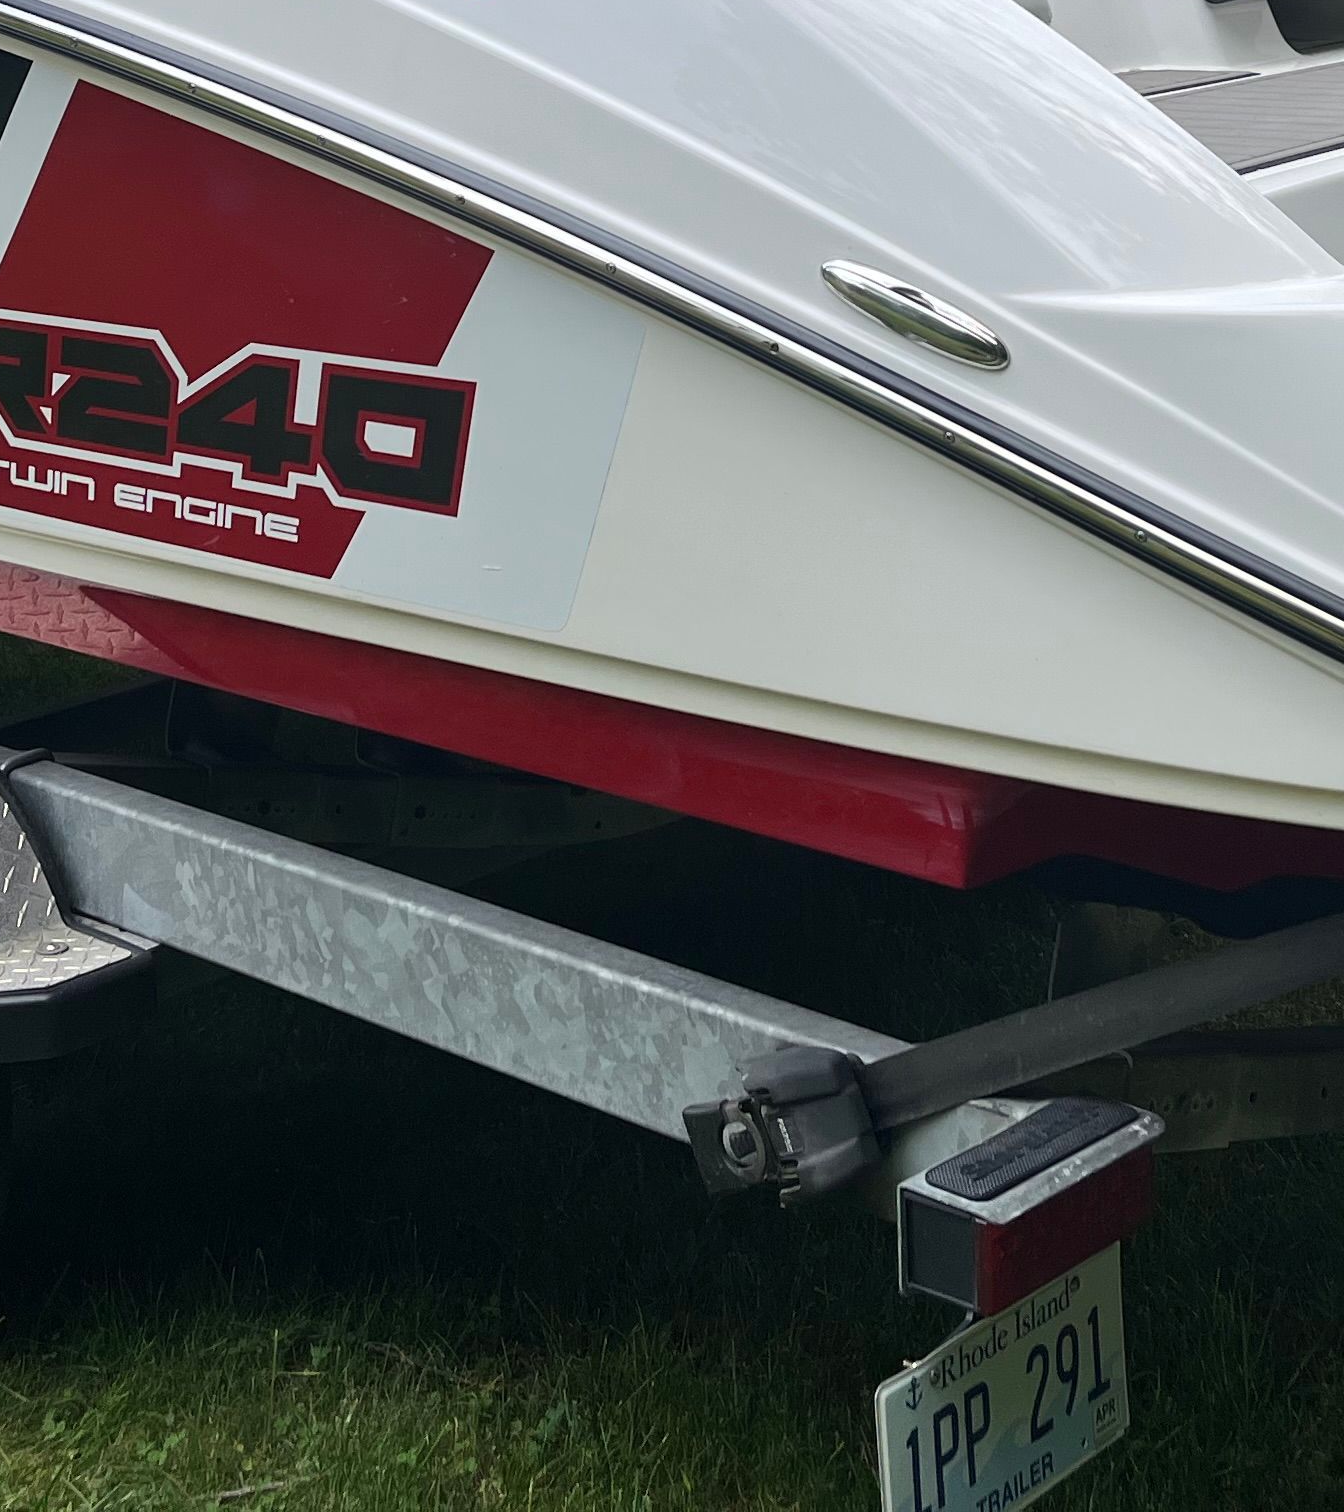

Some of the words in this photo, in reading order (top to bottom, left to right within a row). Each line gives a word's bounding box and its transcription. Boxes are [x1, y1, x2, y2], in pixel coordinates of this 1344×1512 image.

[115, 483, 299, 543] ENGINE
[940, 1323, 1009, 1387] Rhode
[1014, 1286, 1072, 1343] Island
[906, 1381, 991, 1512] 1PP
[1026, 1306, 1111, 1444] 291
[1095, 1398, 1117, 1425] APR
[976, 1451, 1055, 1512] TRAILER
